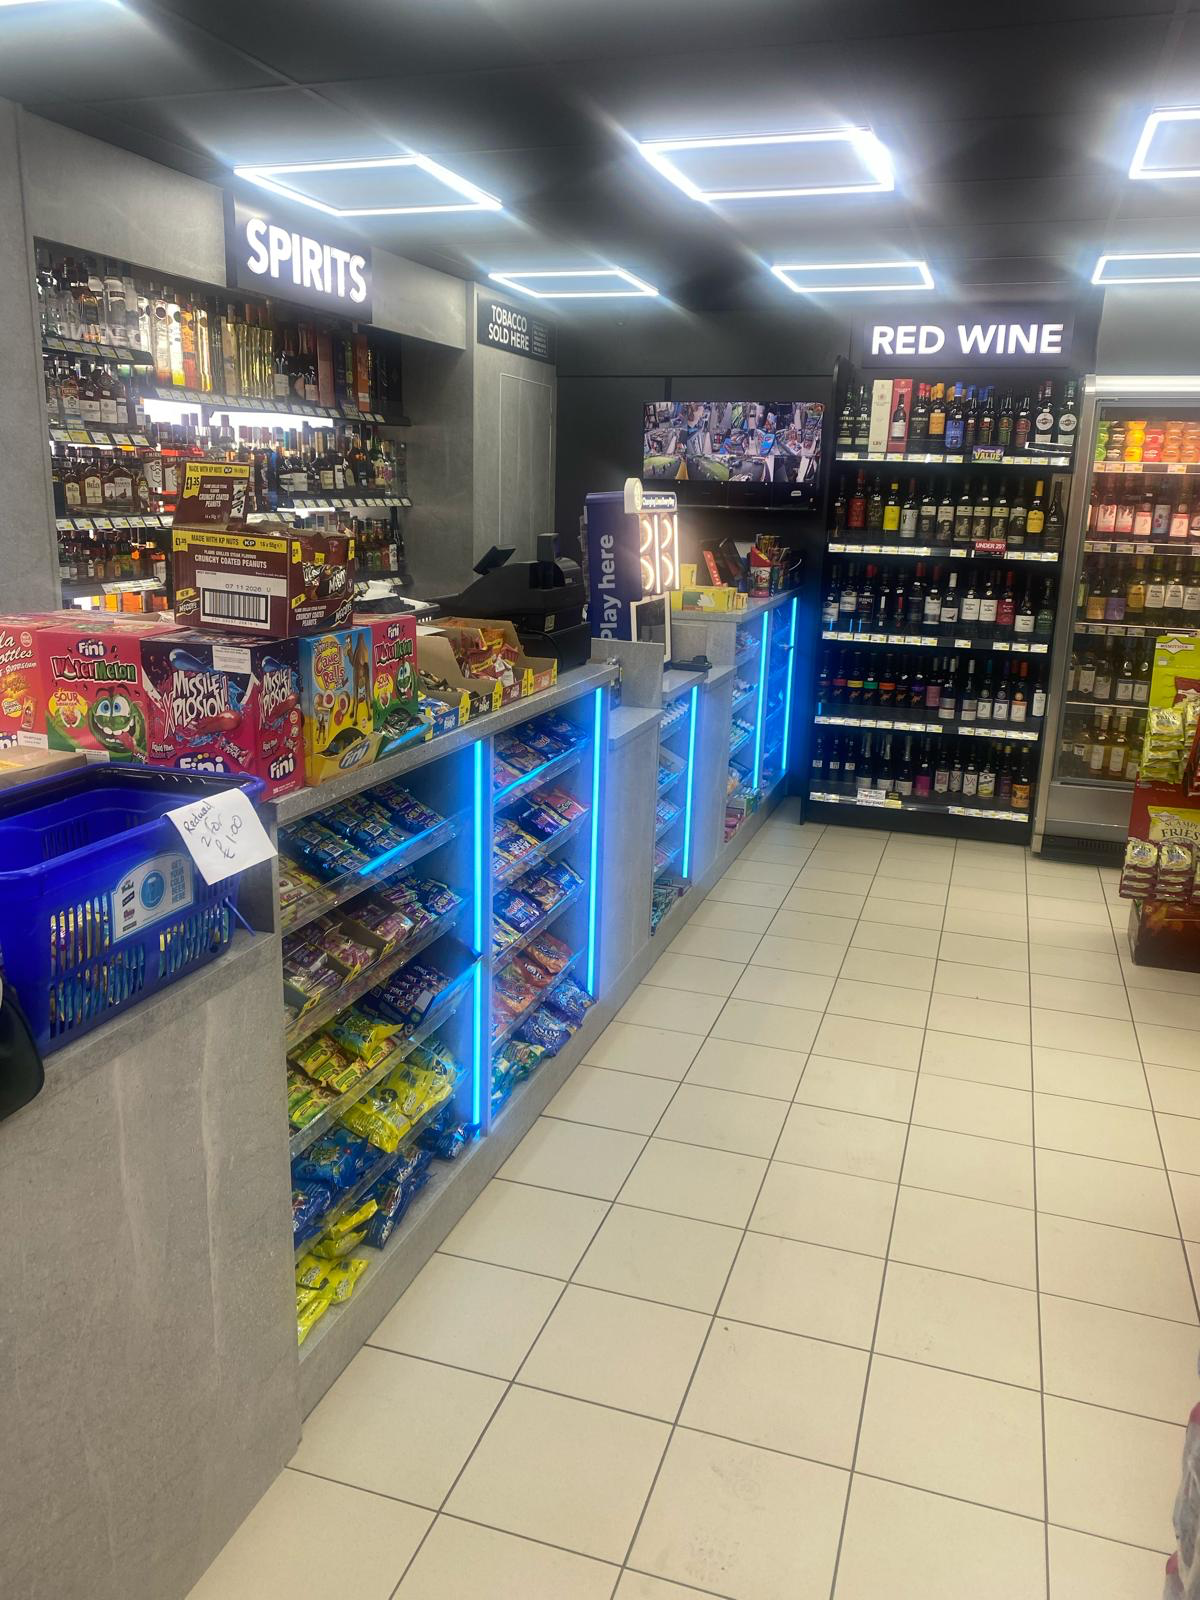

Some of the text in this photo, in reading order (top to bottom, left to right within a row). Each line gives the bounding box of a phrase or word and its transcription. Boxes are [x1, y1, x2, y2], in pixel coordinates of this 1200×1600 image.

[246, 218, 367, 303] SPIRITS
[491, 304, 527, 333] TOBACCO
[488, 322, 509, 344] SOLD
[510, 330, 530, 351] HERE
[871, 324, 1064, 355] RED WINE
[975, 452, 1001, 461] VALUE
[186, 476, 200, 490] £1.35
[191, 534, 204, 543] MADE
[205, 536, 218, 544] WITH
[225, 537, 239, 545] NUTS
[194, 554, 267, 569] CRUNCHY COATED PEANUTS
[598, 534, 615, 589] here
[78, 641, 104, 656] Fini
[172, 670, 221, 699] MISSILE
[54, 692, 80, 703] SOUR
[341, 739, 369, 769] Fini
[271, 753, 294, 779] Fini
[1163, 820, 1199, 830] SCAMPI
[201, 836, 211, 847] 2
[1161, 828, 1200, 841] FRIES
